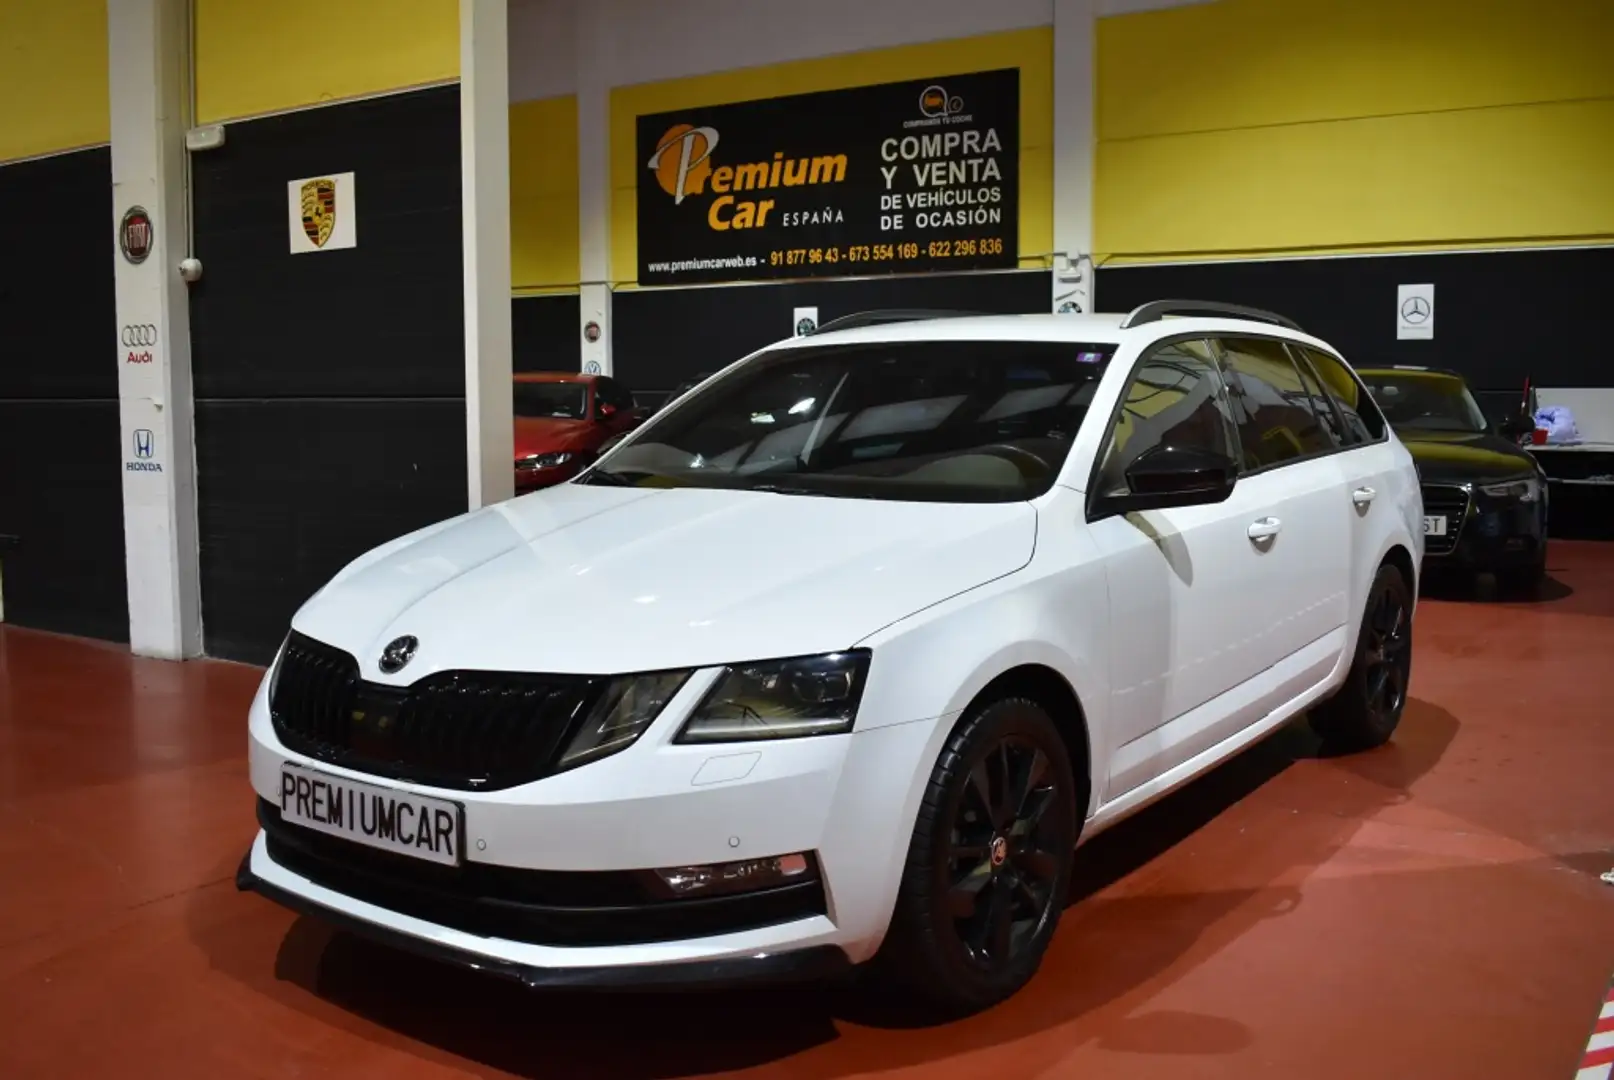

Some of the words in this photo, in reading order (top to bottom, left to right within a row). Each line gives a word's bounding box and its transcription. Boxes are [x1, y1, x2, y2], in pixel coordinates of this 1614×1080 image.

[881, 128, 1001, 162] COMPRA
[648, 126, 848, 205] Premium
[880, 166, 898, 189] Y
[912, 157, 1001, 187] VENTA
[708, 195, 774, 231] Car
[783, 206, 844, 227] ESPAÑA
[881, 194, 902, 210] DE
[906, 186, 1001, 208] VEHÍCULOS
[880, 214, 903, 231] DE
[915, 205, 1001, 229] OCASIÓN
[128, 222, 146, 249] FIAT
[648, 254, 757, 273] www.premiumcarweb.es
[770, 251, 783, 266] 91
[786, 249, 806, 265] 877
[808, 249, 822, 264] 96
[825, 248, 839, 263] 43
[849, 246, 870, 262] 673
[873, 244, 894, 261] 554
[897, 243, 918, 259] 169
[928, 241, 950, 258] 622
[954, 239, 976, 256] 296
[979, 238, 1002, 255] 836
[126, 350, 152, 363] Audi
[126, 462, 162, 472] HONDA
[282, 771, 454, 856] PREMIUMCAR
